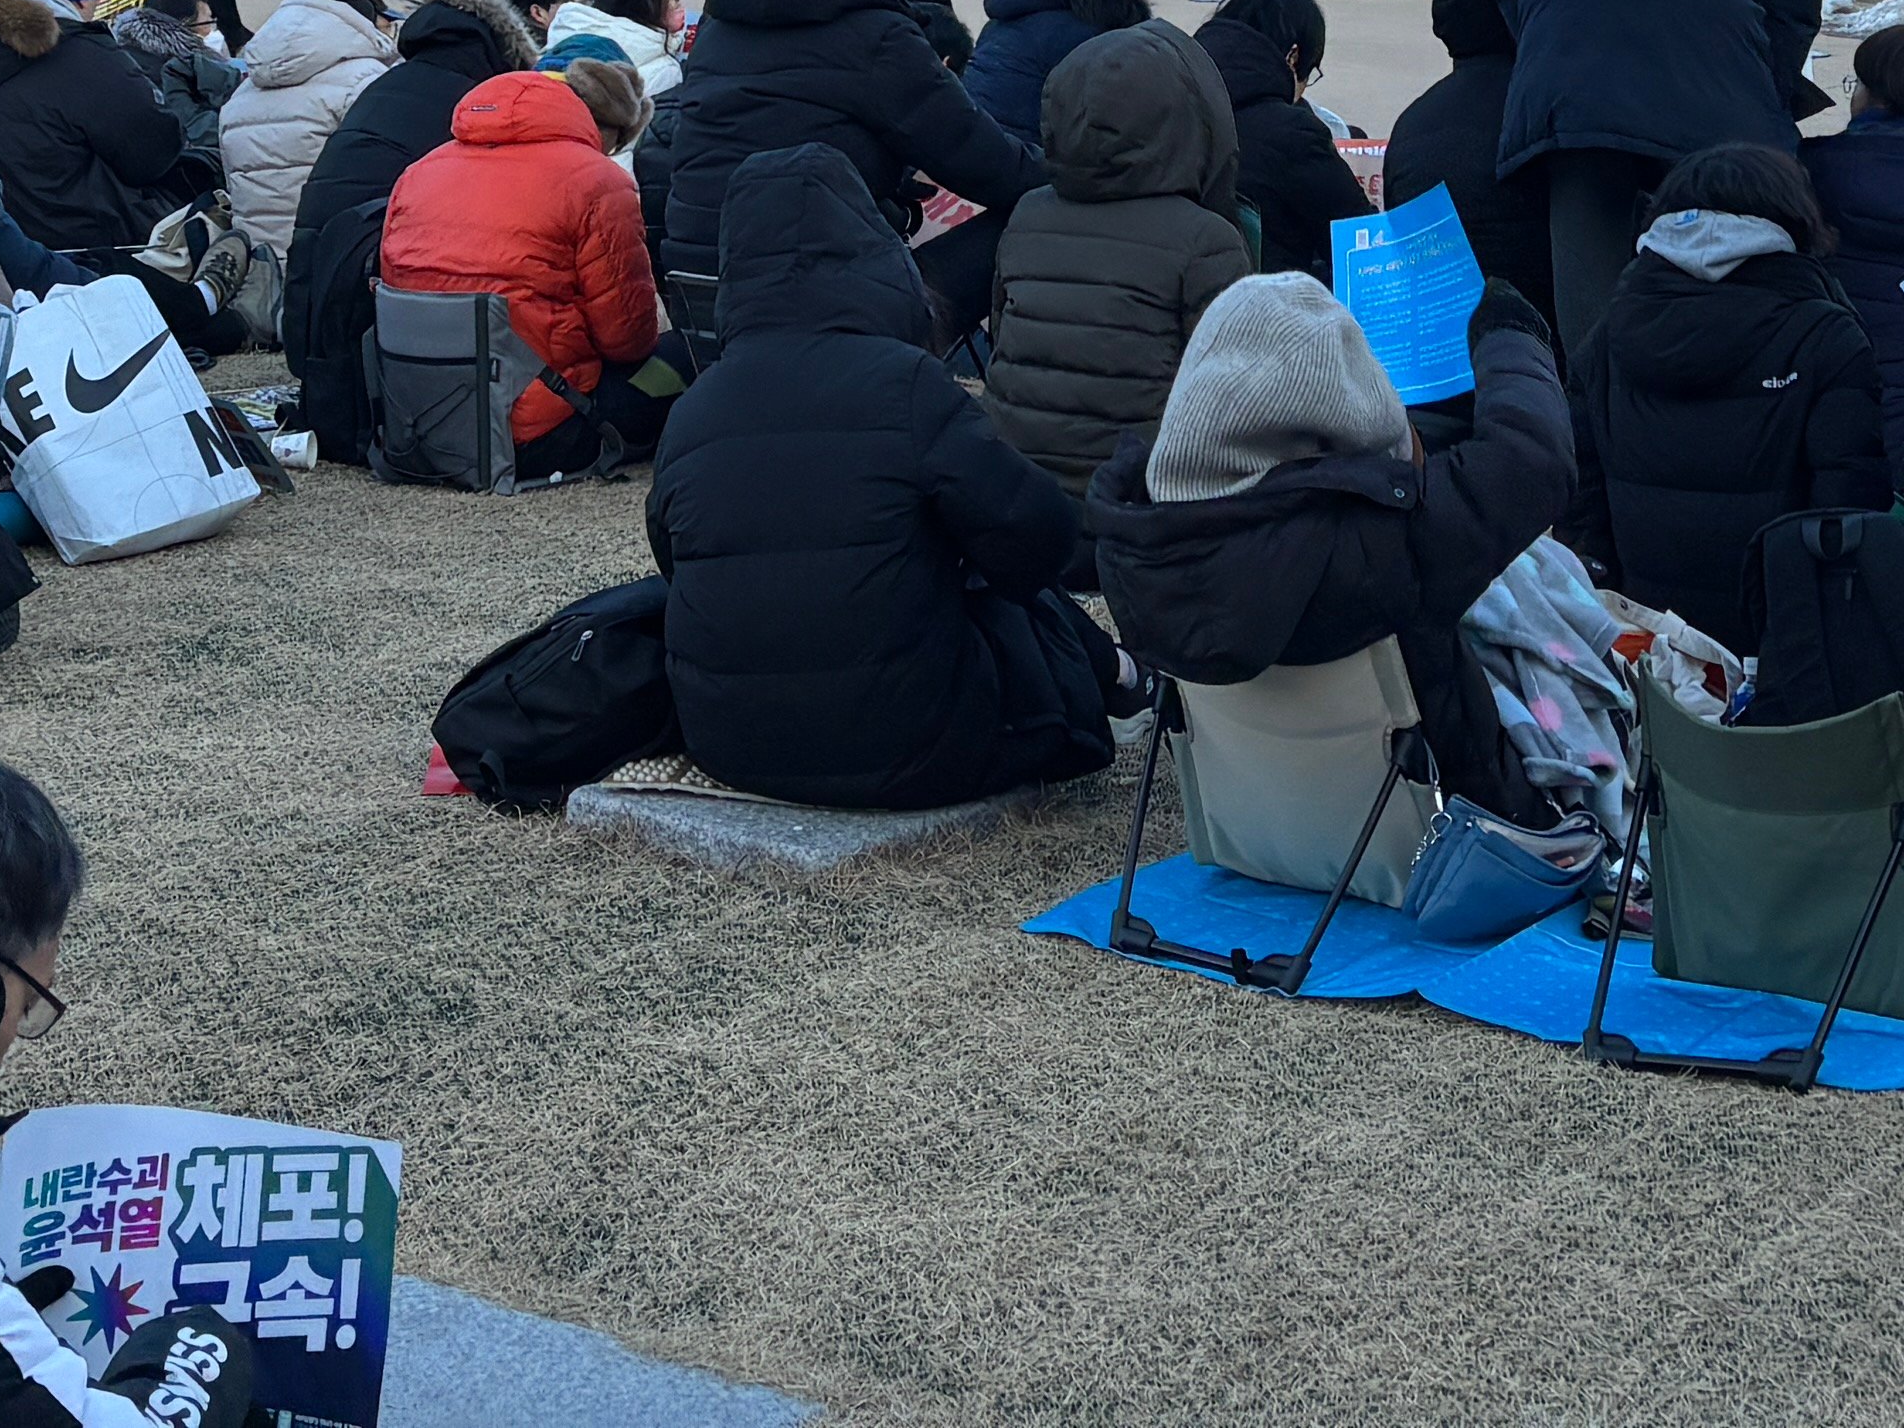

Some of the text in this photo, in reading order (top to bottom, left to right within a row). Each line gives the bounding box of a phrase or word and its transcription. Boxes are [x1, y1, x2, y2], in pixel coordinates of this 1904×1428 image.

[23, 1152, 170, 1211] 내란수괴
[175, 1151, 370, 1248] 체포!
[20, 1195, 164, 1267] 윤석열
[144, 1326, 229, 1428] SWISS
